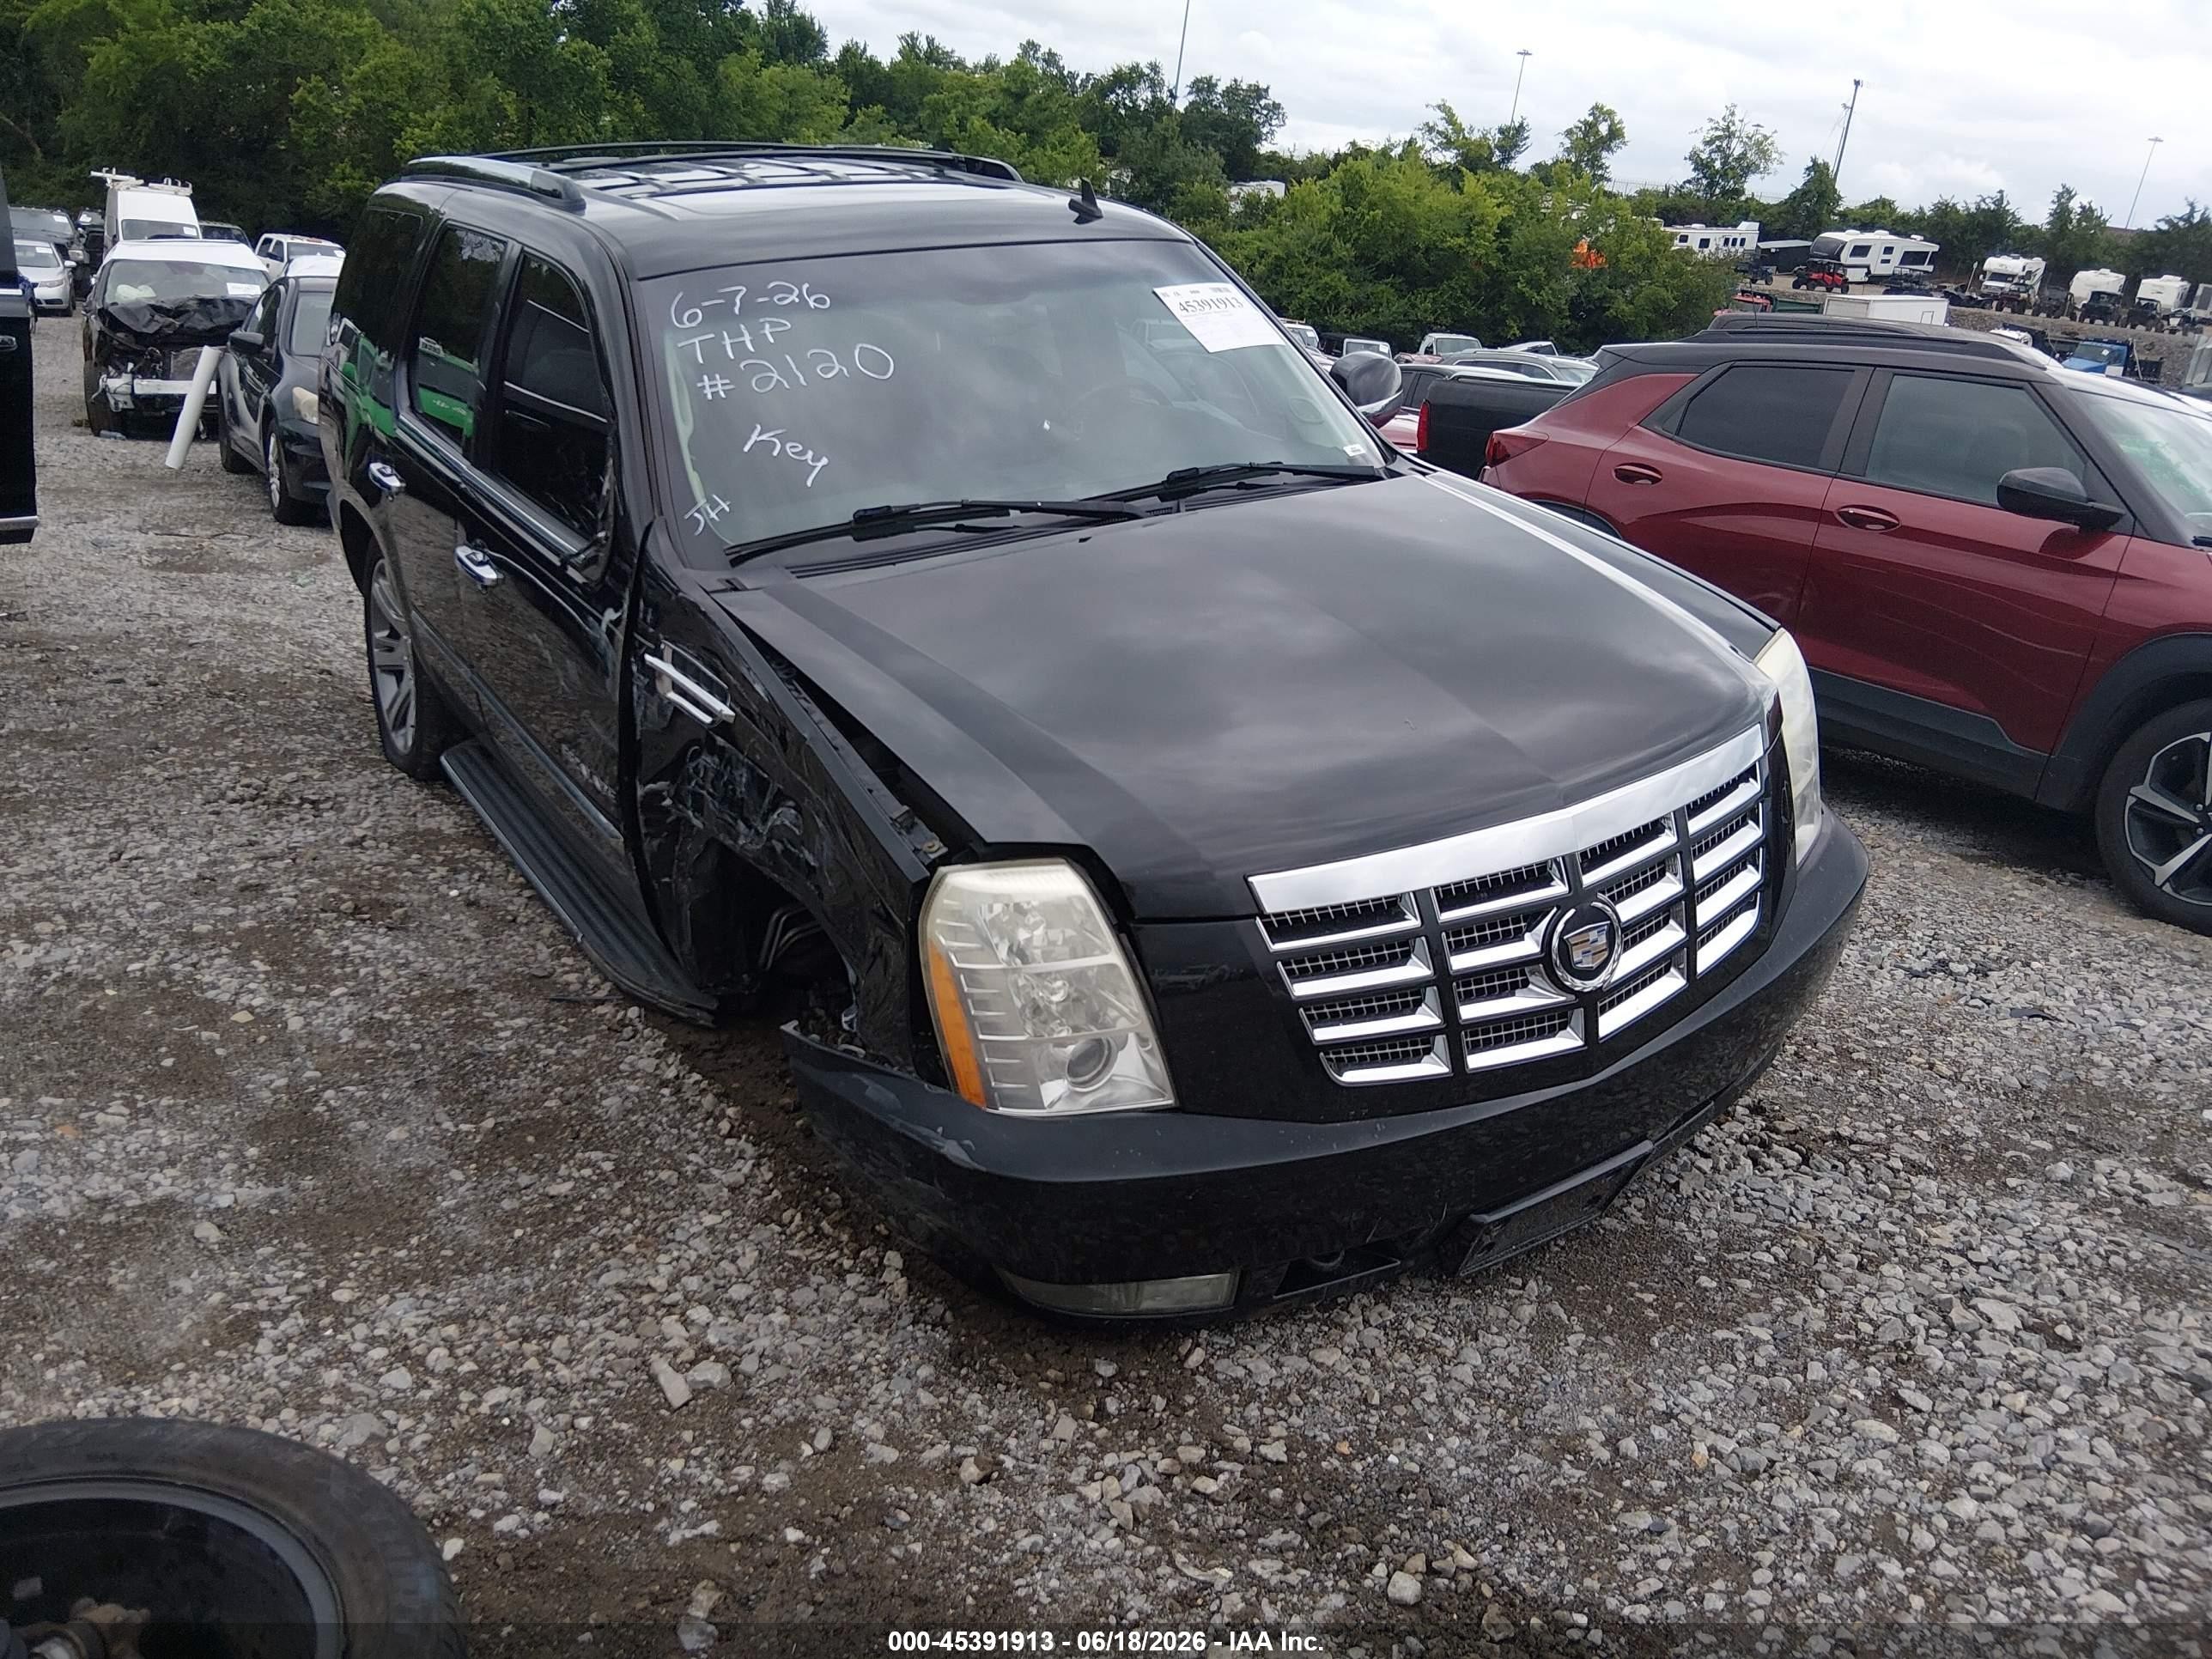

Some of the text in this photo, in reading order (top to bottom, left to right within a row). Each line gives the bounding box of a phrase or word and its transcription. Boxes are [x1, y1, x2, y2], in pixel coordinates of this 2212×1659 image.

[671, 281, 831, 329] 6-7-26
[1179, 296, 1244, 313] 45391913
[678, 318, 792, 364] THP
[739, 343, 895, 393] 2120
[743, 423, 830, 488] Key
